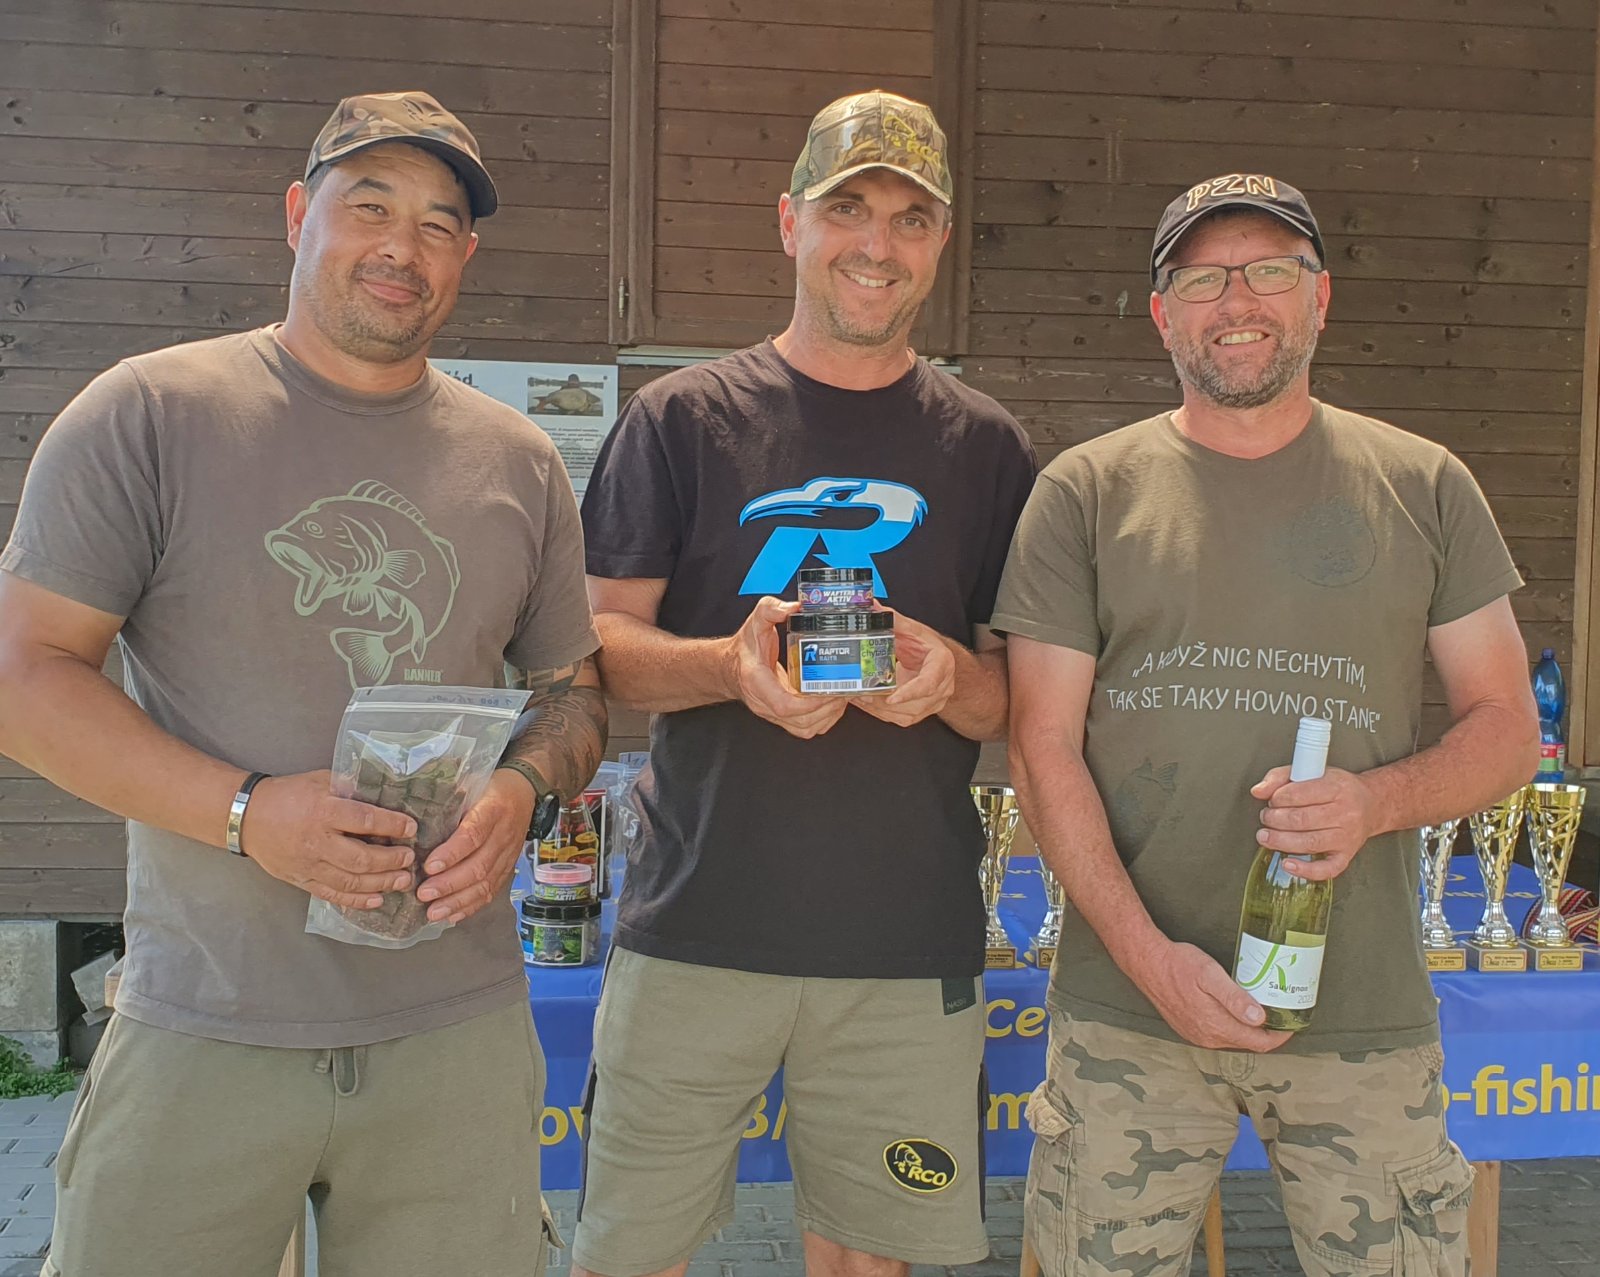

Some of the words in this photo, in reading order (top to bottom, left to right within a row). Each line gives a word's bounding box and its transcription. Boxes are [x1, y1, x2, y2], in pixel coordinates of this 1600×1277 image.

[1186, 173, 1278, 213] PZN
[818, 647, 850, 656] RAPTOR
[1156, 641, 1208, 671] KDYŽ
[1212, 646, 1251, 668] NIC
[1257, 647, 1366, 694] NECHYTÍM,
[1106, 689, 1138, 712] TAK
[1140, 686, 1164, 709] SE
[1168, 684, 1230, 710] TAKY
[1234, 688, 1317, 717] HOVNO
[1442, 1062, 1600, 1116] -fishi
